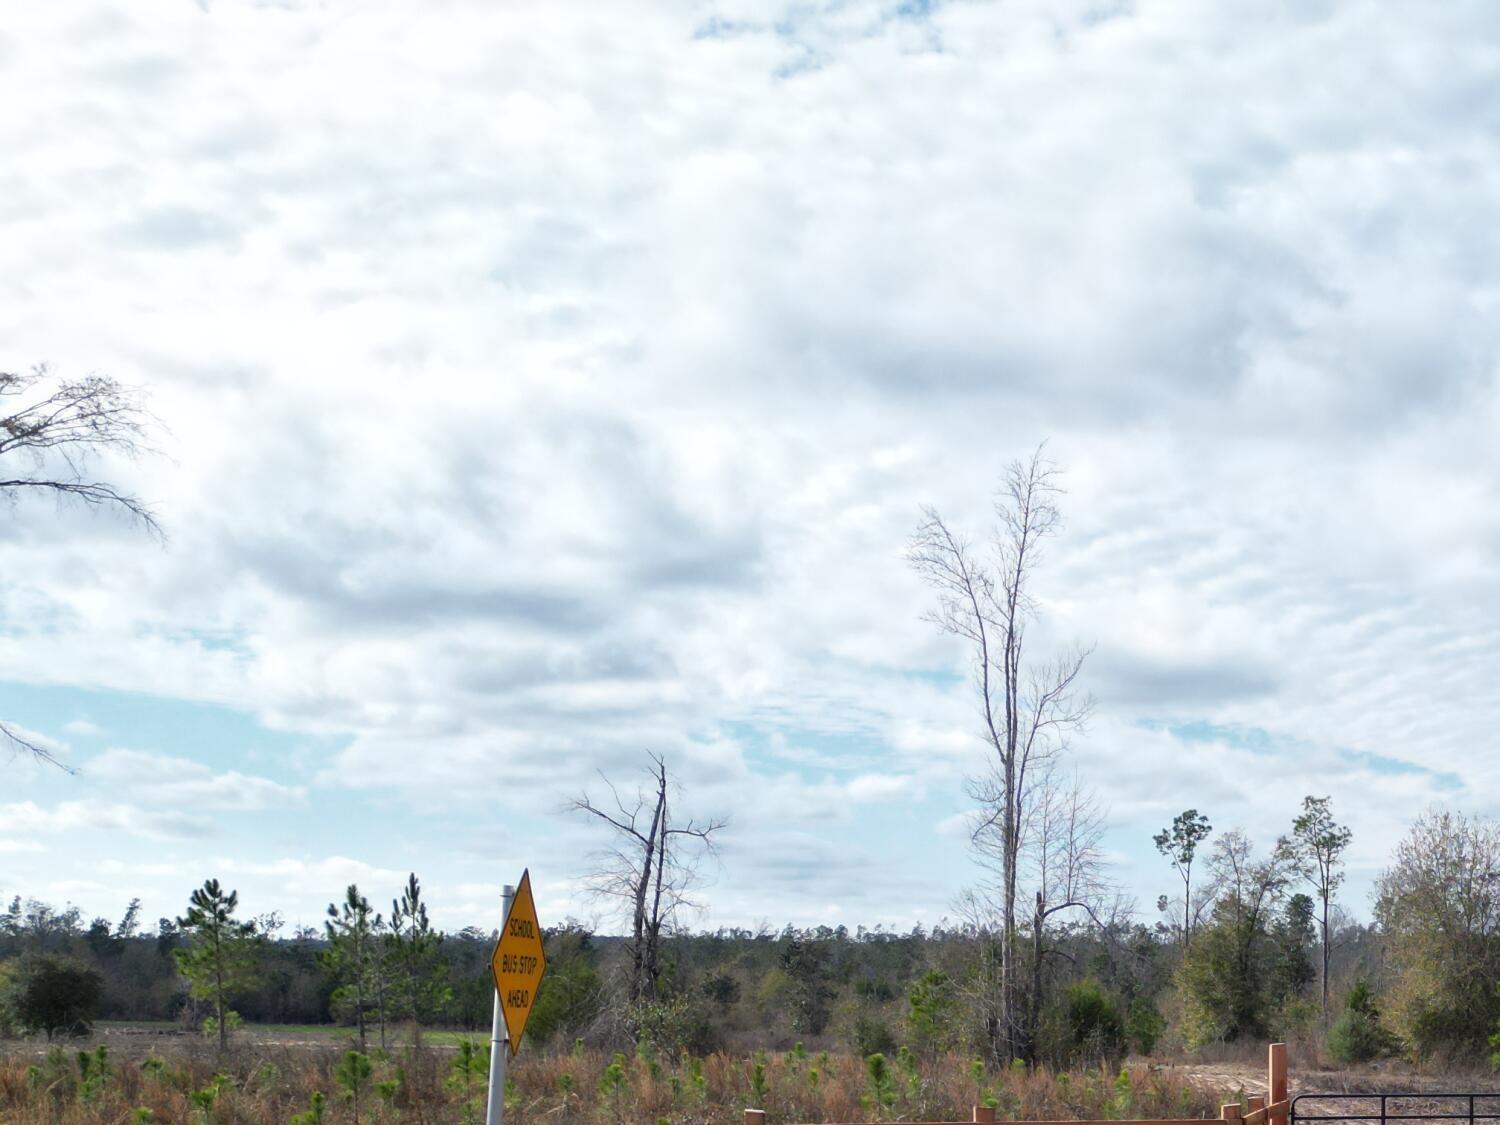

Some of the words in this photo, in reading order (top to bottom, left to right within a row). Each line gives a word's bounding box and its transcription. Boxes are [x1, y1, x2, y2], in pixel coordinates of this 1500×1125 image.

[509, 917, 535, 939] SCHOOL
[502, 954, 518, 973] BUS
[518, 955, 537, 975] STOP
[506, 989, 529, 1009] AHEAD
